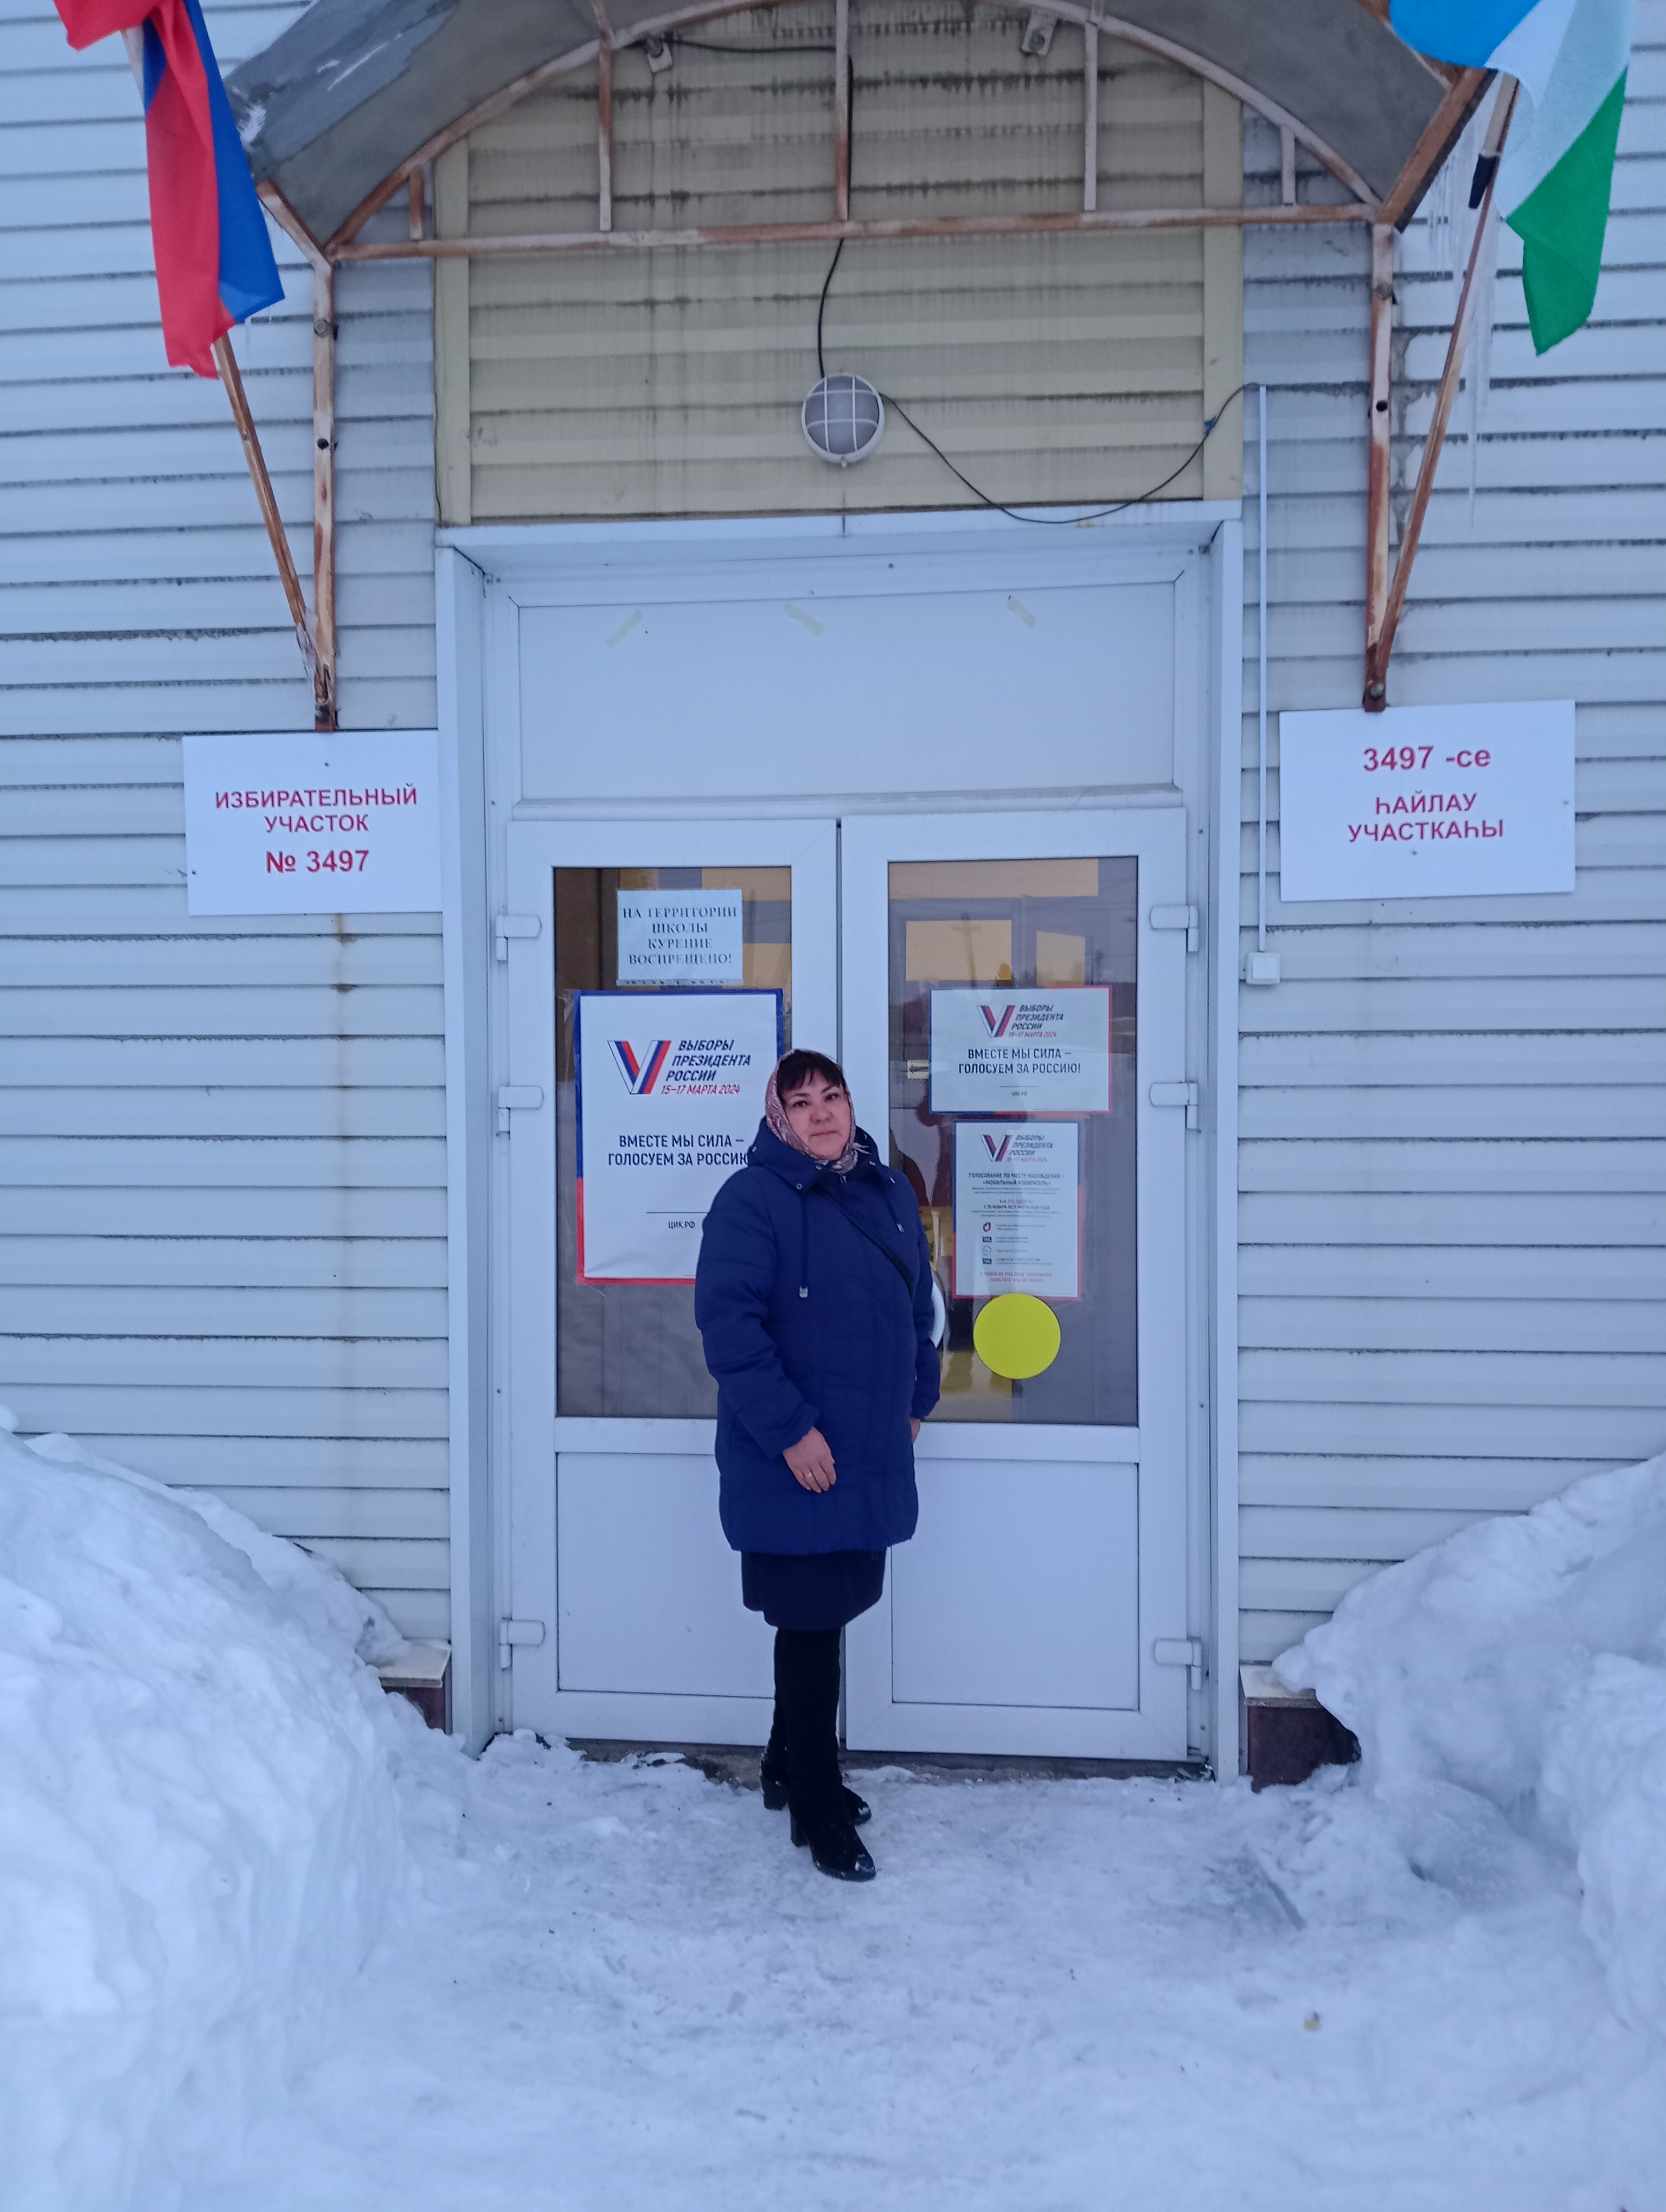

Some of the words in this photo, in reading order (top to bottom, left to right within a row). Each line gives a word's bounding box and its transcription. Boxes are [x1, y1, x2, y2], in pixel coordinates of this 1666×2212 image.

[1363, 745, 1434, 772] 3497
[1446, 749, 1491, 768] -се
[215, 783, 417, 808] ИЗБИРАТЕЛЬНЫЙ
[264, 814, 369, 833] УЧАСТОК
[265, 851, 296, 873] №
[306, 850, 369, 873] 3497
[623, 908, 642, 918] НА
[648, 907, 737, 918] ТЕРРИТОРИИ
[652, 923, 708, 934] ШКОЛЫ
[648, 938, 713, 949] КУРЕНИЕ
[629, 954, 732, 965] ВОСПРЕЩЕНО!
[678, 1039, 734, 1051] ВЫБОРЫ
[968, 1049, 1008, 1059] ВМЕСТЕ
[1012, 1049, 1030, 1059] МЫ
[1034, 1049, 1062, 1059] СИЛА
[672, 1054, 751, 1068] ПРЕЗИДЕНТА
[959, 1063, 1013, 1074] ГОЛОСУЕМ
[1017, 1063, 1029, 1073] ЗА
[1033, 1063, 1080, 1073] РОССИЮ!
[665, 1070, 717, 1082] РОССИИ
[687, 1085, 716, 1094] МАРТА
[719, 1084, 740, 1094] 2024
[619, 1135, 668, 1147] ВМЕСТЕ
[672, 1135, 694, 1147] МЫ
[698, 1135, 732, 1147] СИЛА
[608, 1153, 674, 1165] ГОЛОСУЕМ
[677, 1153, 693, 1165] ЗА
[668, 1221, 695, 1229] ЦИК.РФ
